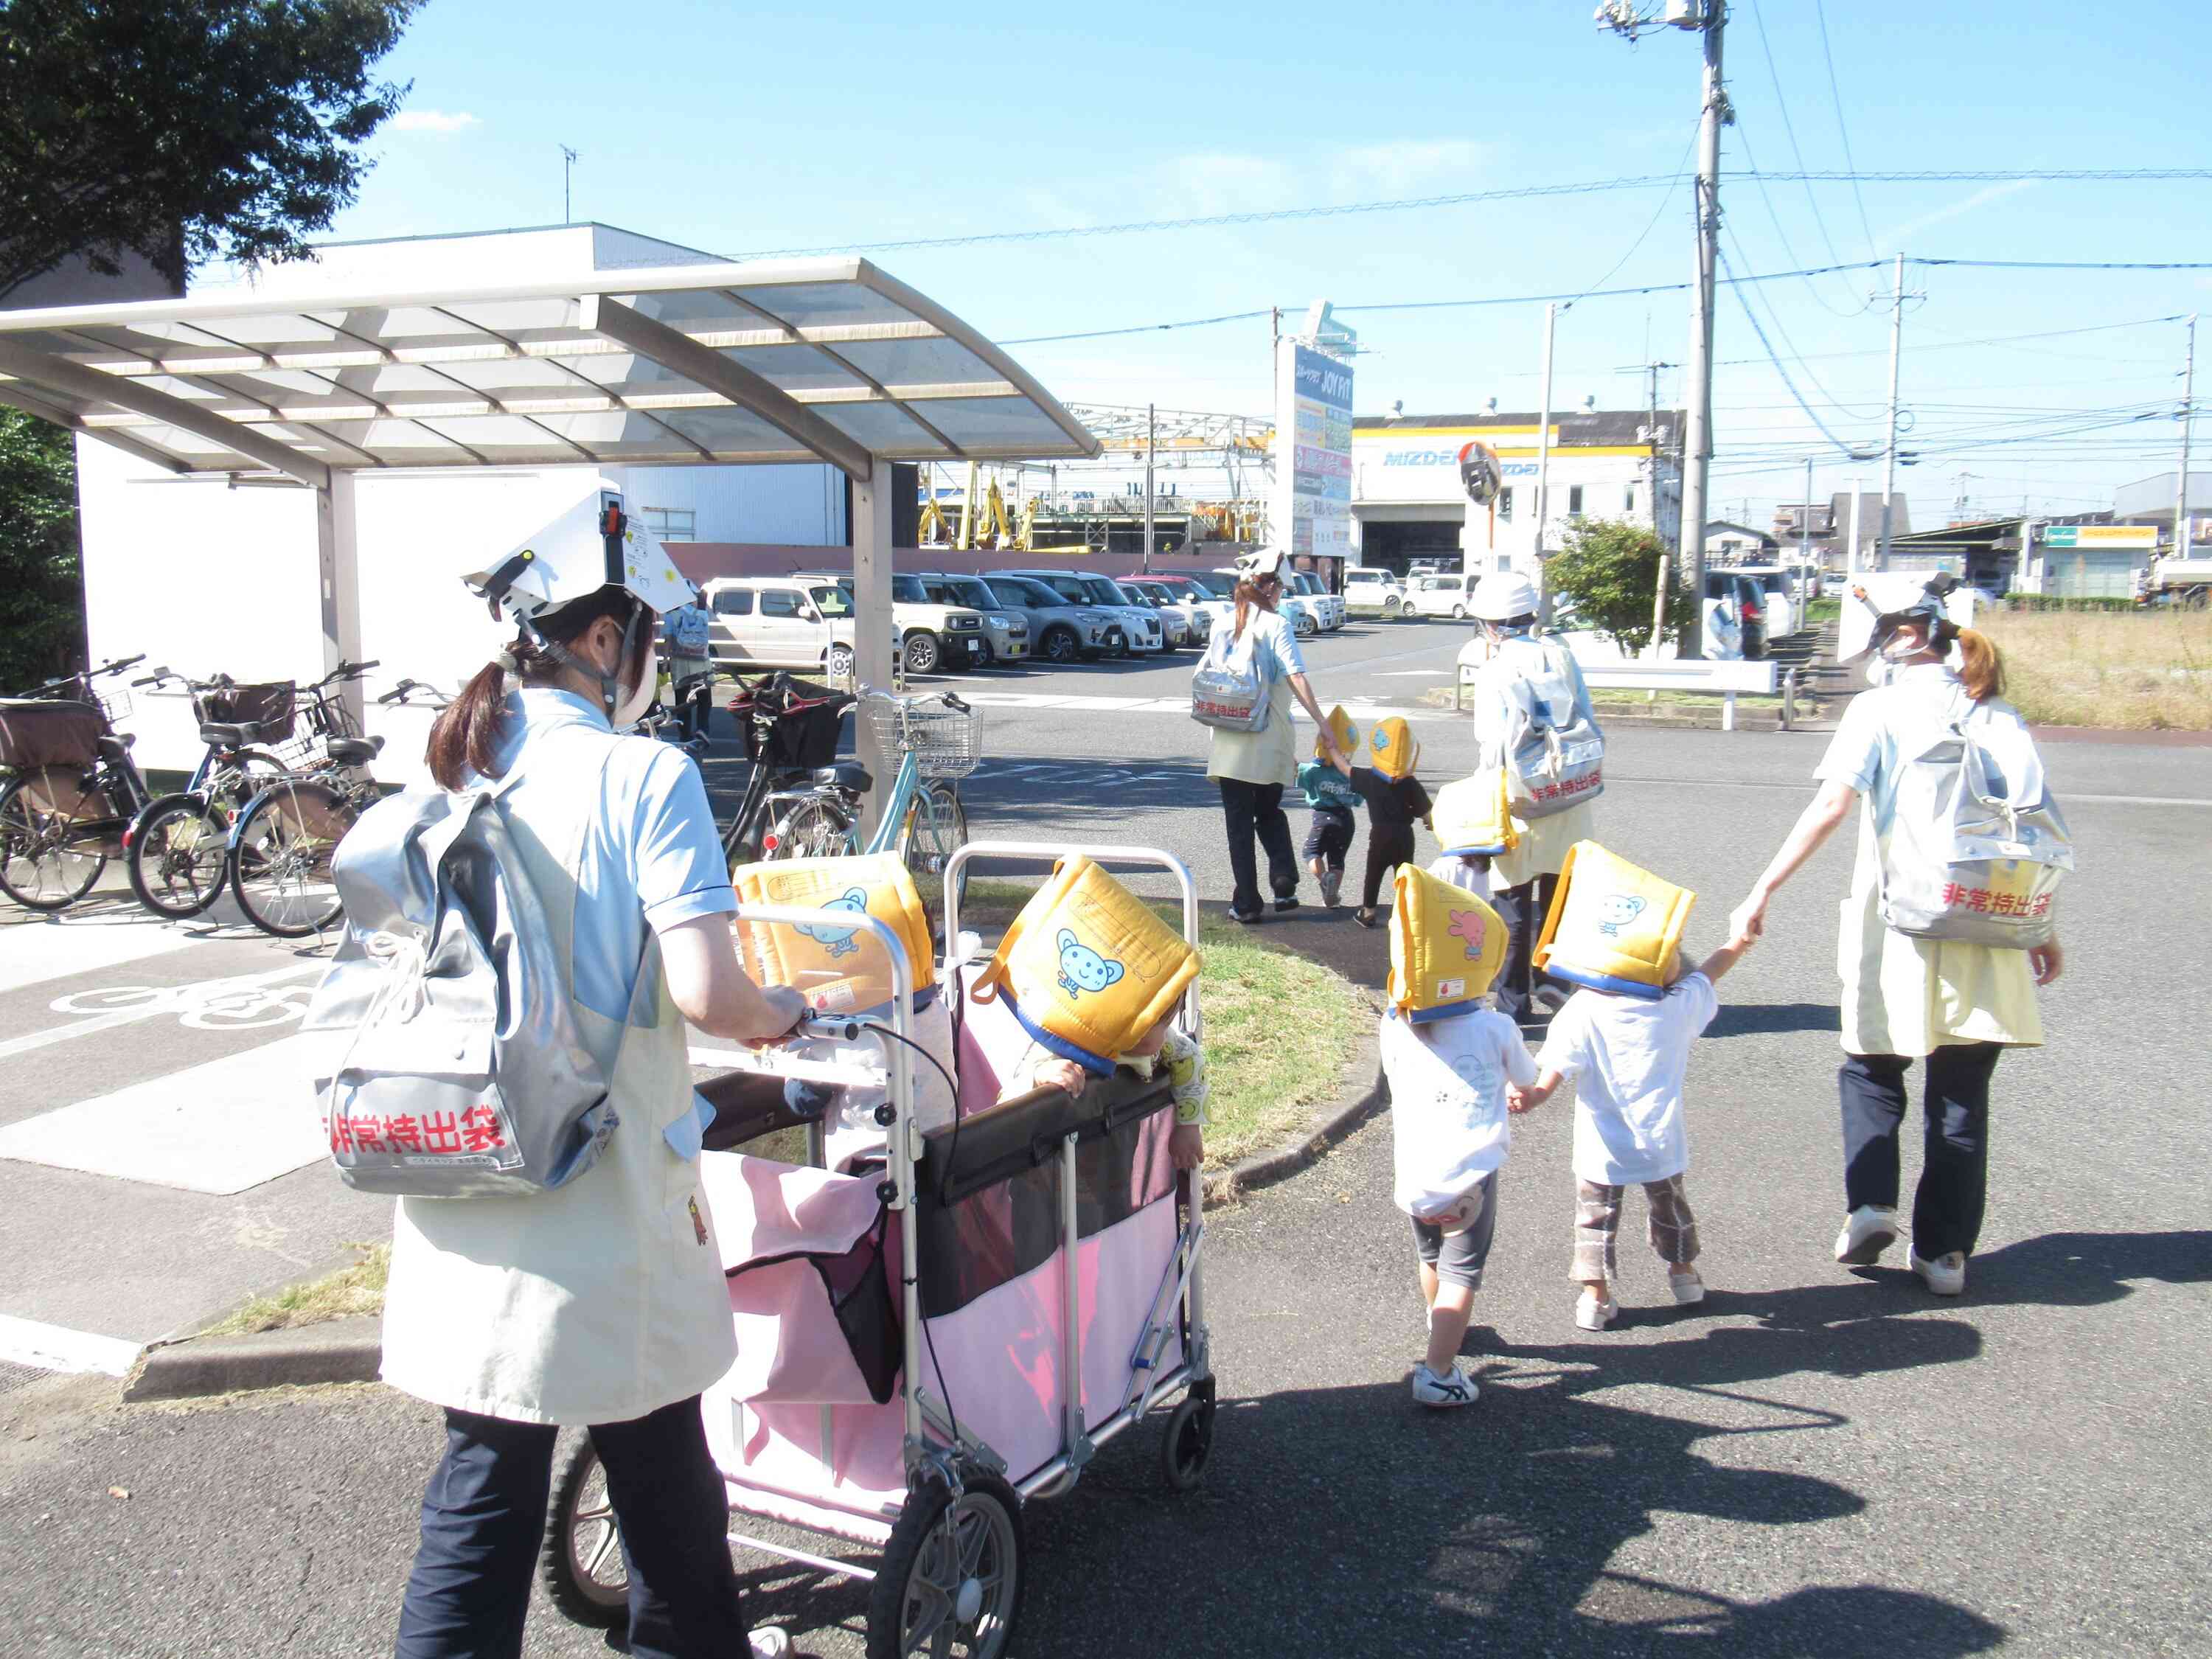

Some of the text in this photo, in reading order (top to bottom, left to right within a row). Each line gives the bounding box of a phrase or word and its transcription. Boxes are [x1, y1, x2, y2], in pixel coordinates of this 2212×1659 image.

[1194, 700, 1252, 719] 非常持出袋
[1530, 768, 1602, 801] 非常持出袋
[1942, 883, 2053, 916] 非常持出袋
[322, 1104, 507, 1155] 非常持出袋
